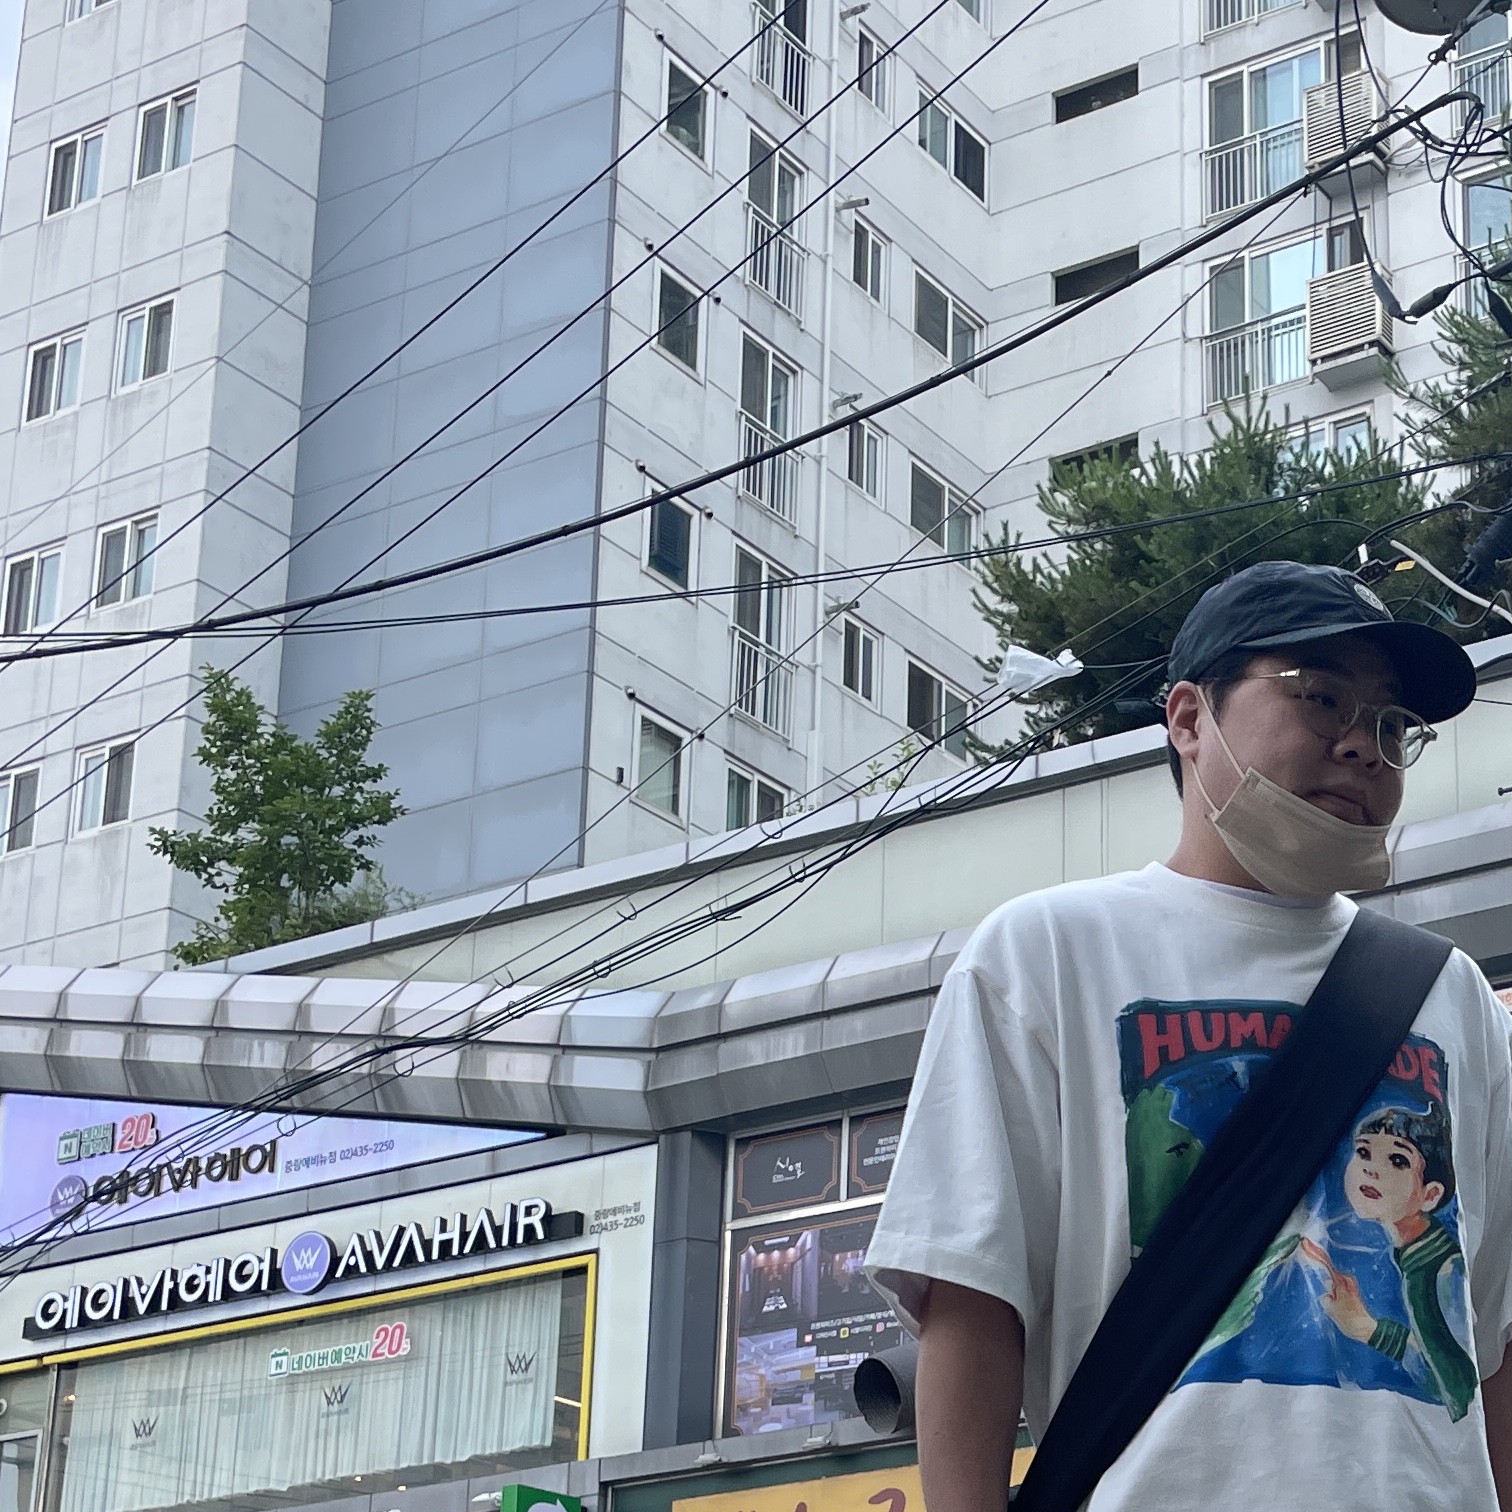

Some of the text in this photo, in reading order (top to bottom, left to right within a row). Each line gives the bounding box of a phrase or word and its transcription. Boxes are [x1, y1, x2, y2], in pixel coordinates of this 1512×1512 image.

[339, 1139, 395, 1161] 02)435-2250
[335, 1197, 549, 1278] AVAHAIR
[590, 1214, 645, 1235] 02)435-2250
[34, 1247, 271, 1332] 에이바헤어
